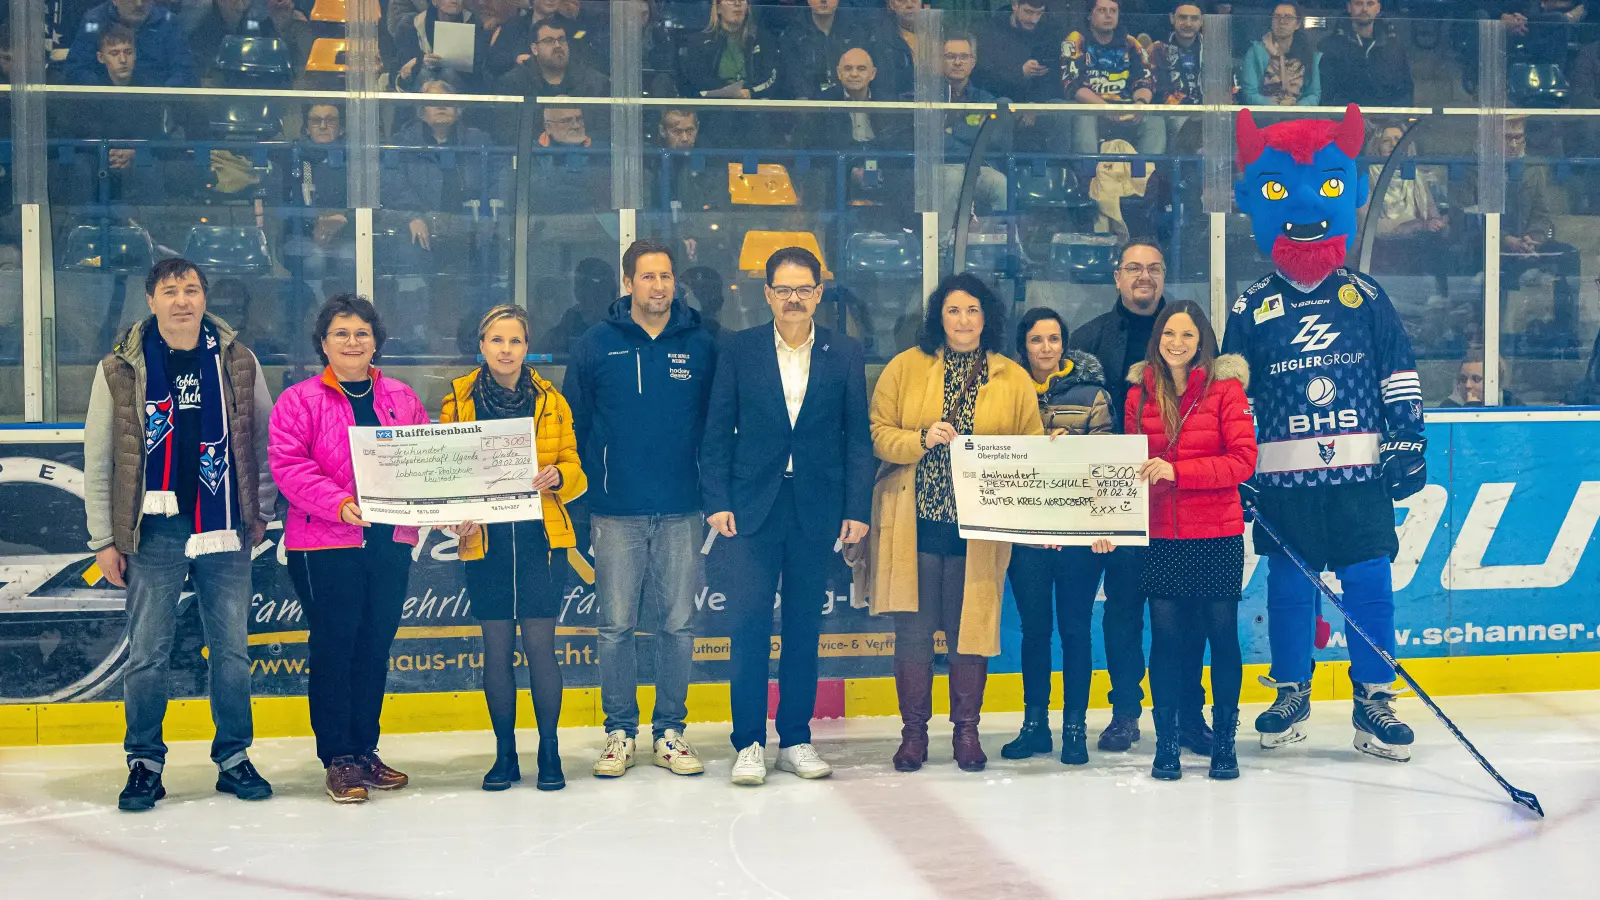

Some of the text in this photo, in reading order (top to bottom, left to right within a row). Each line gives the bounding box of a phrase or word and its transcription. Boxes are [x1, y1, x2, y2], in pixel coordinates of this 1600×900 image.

[1298, 299, 1330, 307] BAUER
[1288, 409, 1359, 434] BHS
[395, 425, 483, 438] Raiffeisenbank
[977, 444, 1011, 453] Sparkasse
[1379, 441, 1423, 454] AUER
[977, 452, 1028, 460] Oberpfalz Nord
[1096, 479, 1133, 488] WEIDEN
[1016, 497, 1042, 506] KREIS
[851, 640, 859, 650] &
